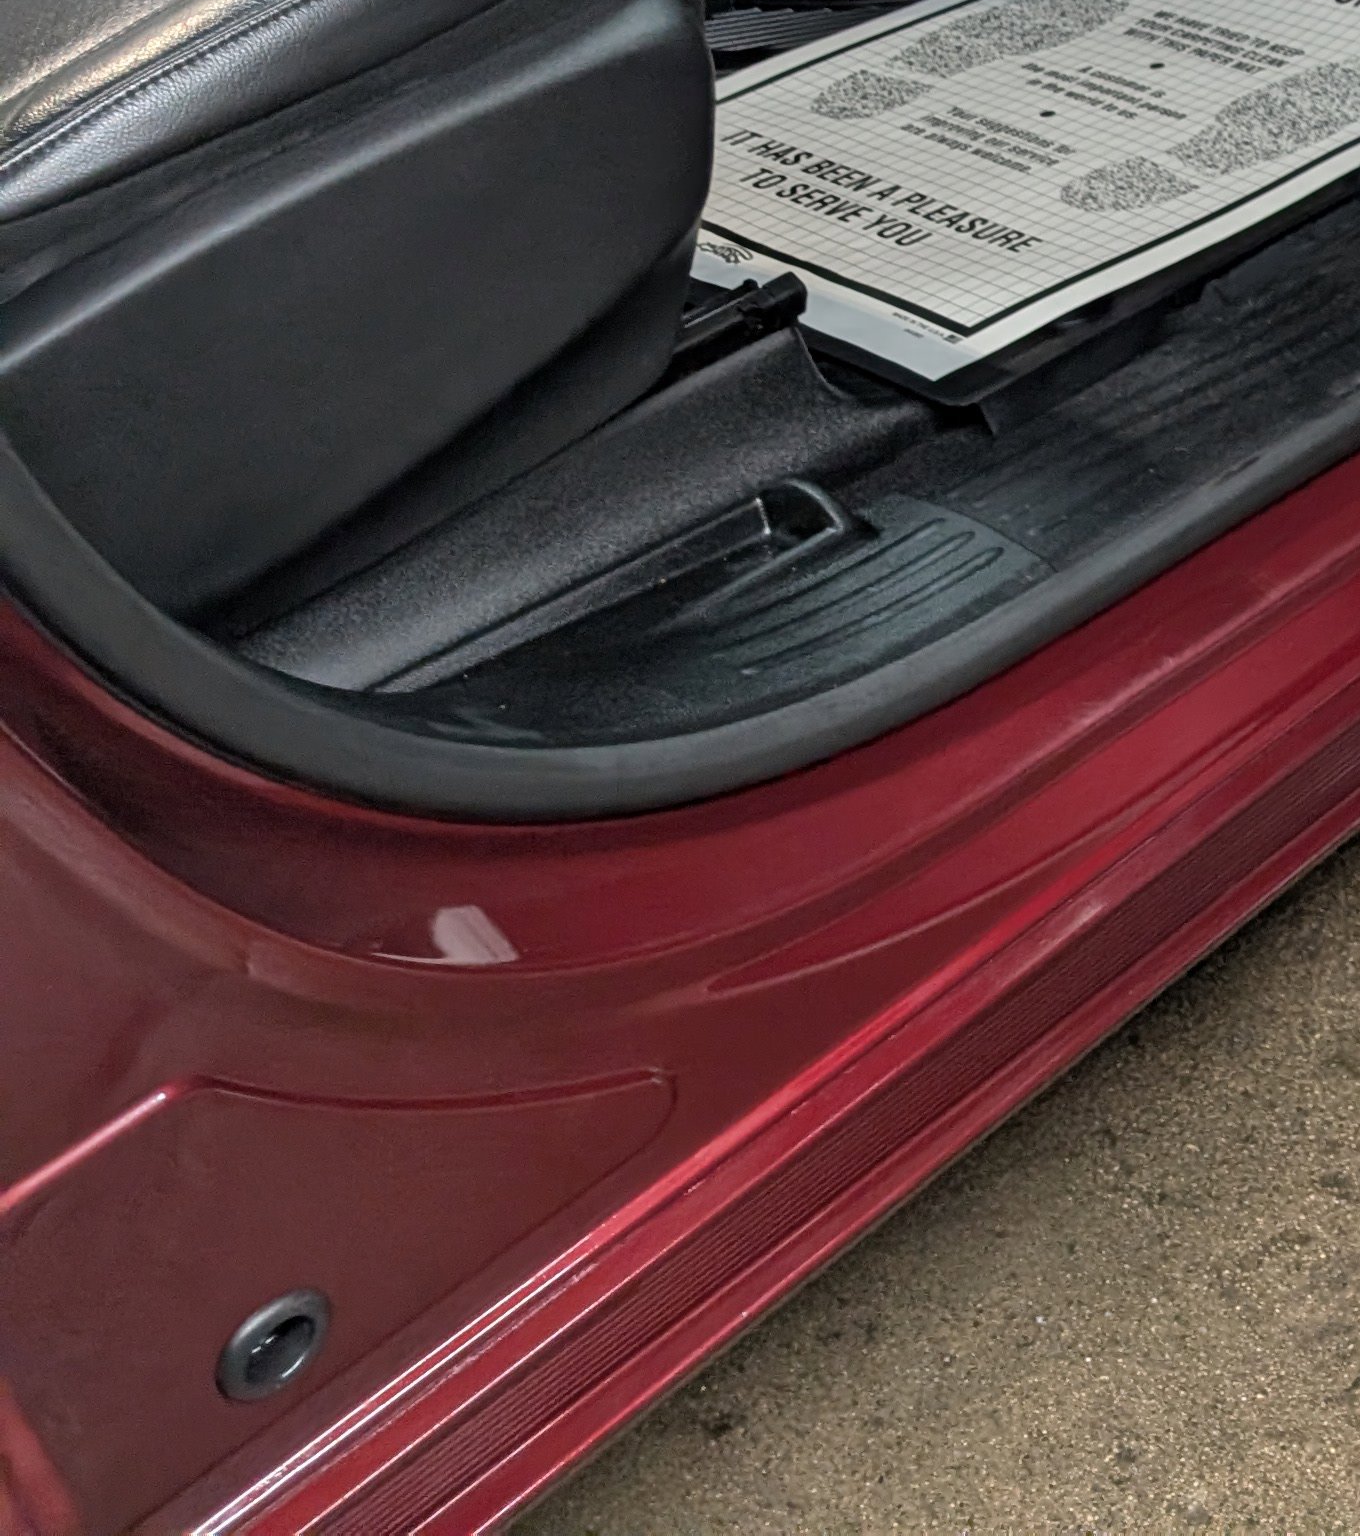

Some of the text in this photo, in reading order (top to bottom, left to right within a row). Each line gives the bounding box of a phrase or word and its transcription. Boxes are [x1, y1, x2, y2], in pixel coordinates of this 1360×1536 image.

[1135, 18, 1173, 33] YOUR
[1241, 50, 1290, 68] CLEAN
[1157, 37, 1192, 53] THIS
[1188, 47, 1235, 66] PAPER
[1230, 61, 1267, 75] MAT
[1210, 26, 1250, 42] TRIED
[1250, 37, 1270, 49] TO
[1267, 43, 1306, 58] KEEP
[1076, 79, 1144, 106] important
[1137, 101, 1188, 121] person
[900, 123, 927, 136] are
[924, 132, 973, 152] always
[974, 117, 1055, 150] suggestions
[983, 136, 1012, 149] our
[720, 129, 1044, 254] IT HAS BEEN A PLEASURE
[739, 167, 934, 248] TO SERVE YOU
